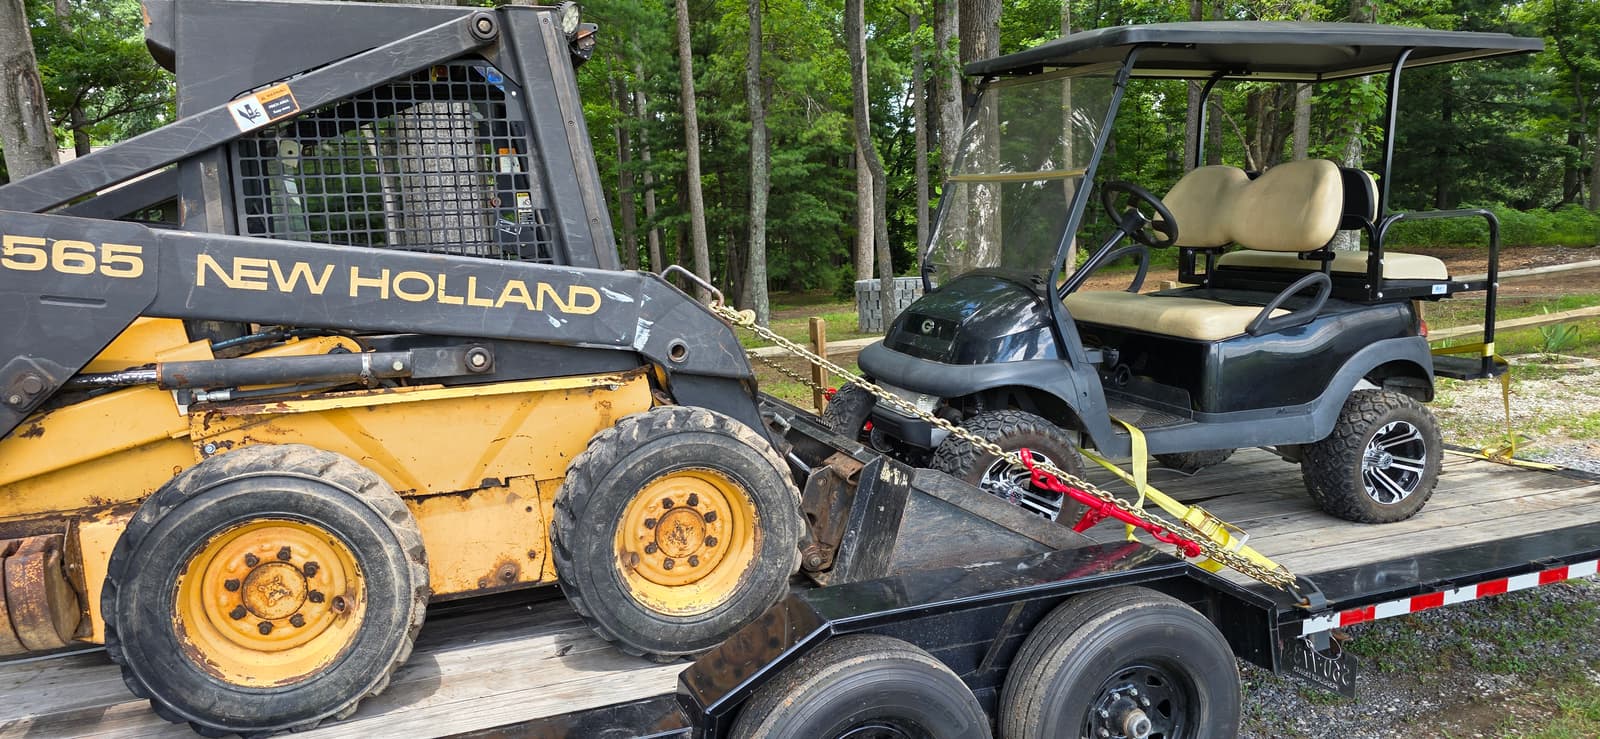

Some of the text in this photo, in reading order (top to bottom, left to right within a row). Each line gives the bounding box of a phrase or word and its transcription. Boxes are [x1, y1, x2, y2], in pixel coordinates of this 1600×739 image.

[1, 234, 144, 279] 565
[196, 253, 602, 315] NEW HOLLAND
